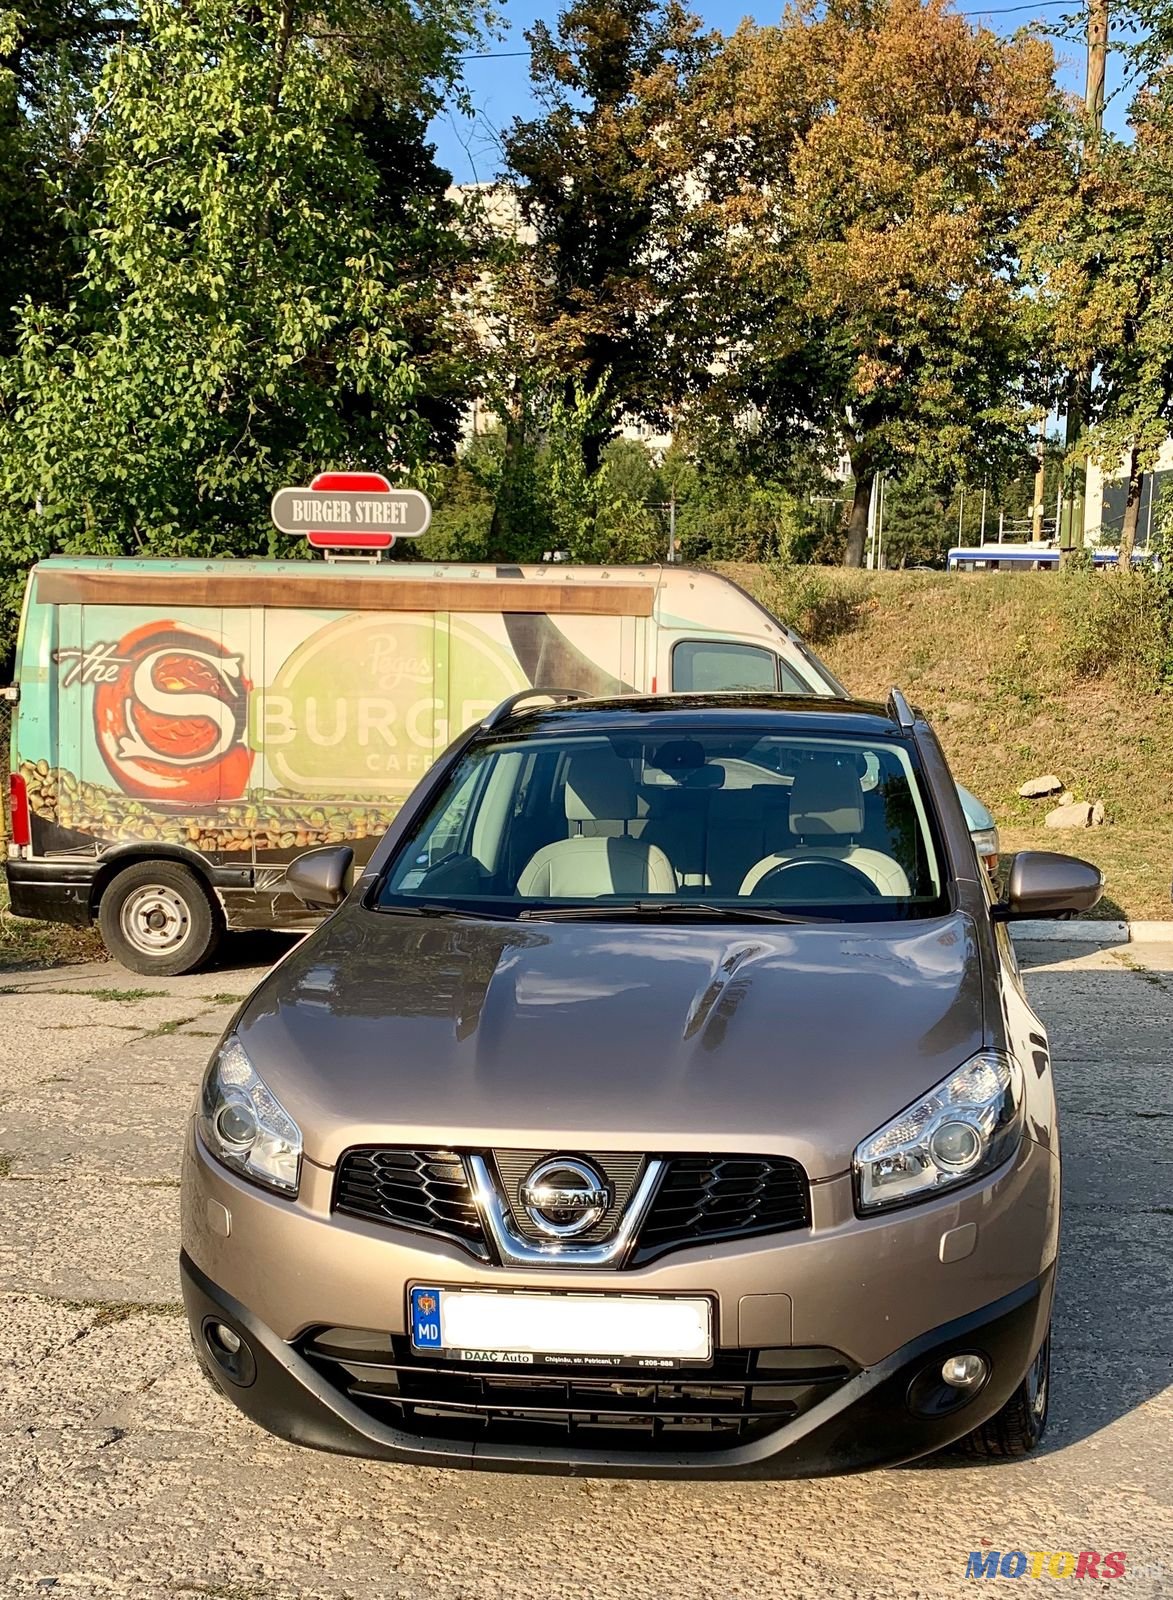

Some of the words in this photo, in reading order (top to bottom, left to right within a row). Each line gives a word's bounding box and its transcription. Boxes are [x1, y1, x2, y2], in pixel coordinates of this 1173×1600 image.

[292, 499, 352, 522] BURGER
[355, 501, 408, 524] STREET
[366, 633, 435, 690] Pegas
[528, 1190, 597, 1206] NSSAN
[418, 1323, 438, 1340] MD
[464, 1351, 498, 1362] DAAC
[502, 1353, 530, 1363] Auto
